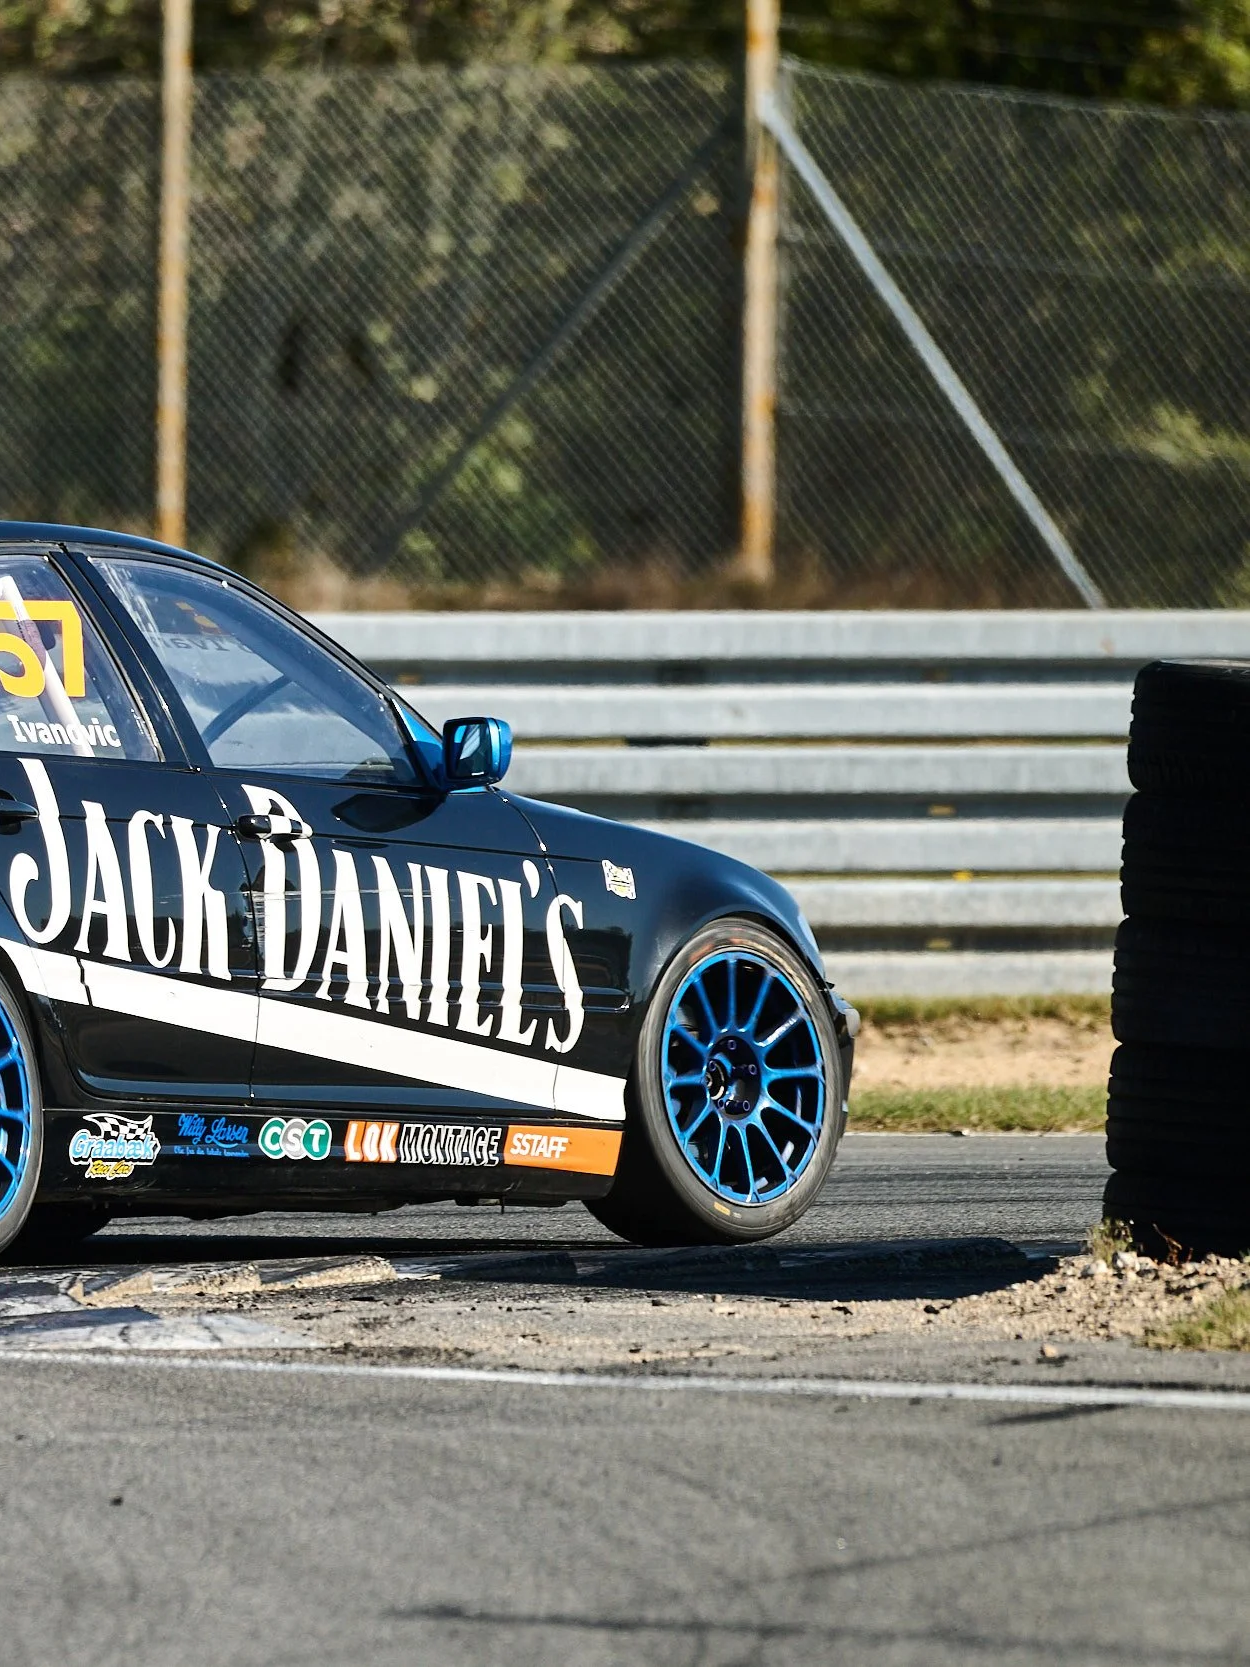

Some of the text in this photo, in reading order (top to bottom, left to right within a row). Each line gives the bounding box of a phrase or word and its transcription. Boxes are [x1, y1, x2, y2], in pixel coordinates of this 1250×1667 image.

[6, 714, 122, 748] Ivanovic
[9, 757, 585, 1054] JACK DANIEL'S
[178, 1112, 207, 1145] Willy
[264, 1125, 327, 1154] CST
[346, 1121, 502, 1167] LOK MONTAGE
[509, 1132, 570, 1159] SSTAFF
